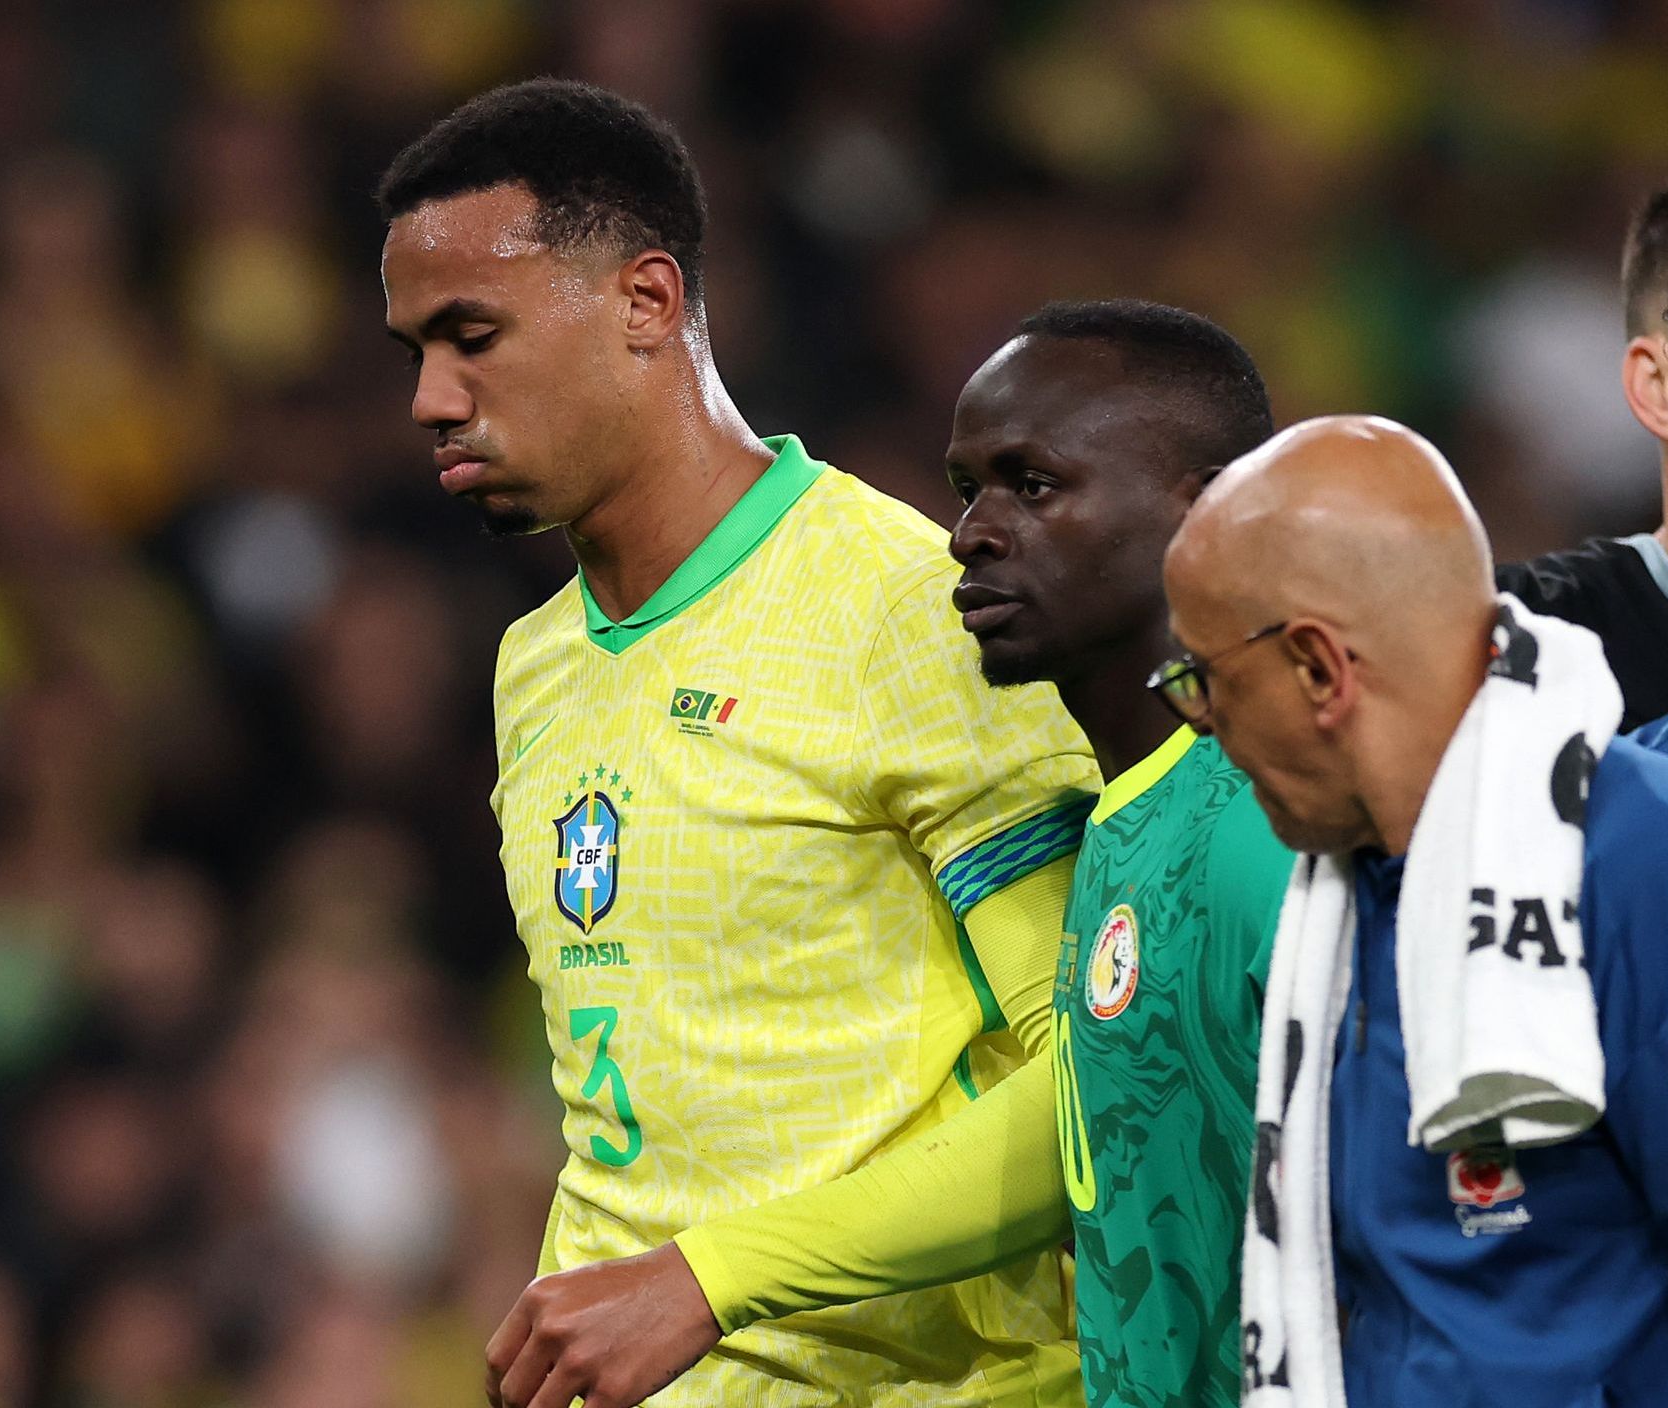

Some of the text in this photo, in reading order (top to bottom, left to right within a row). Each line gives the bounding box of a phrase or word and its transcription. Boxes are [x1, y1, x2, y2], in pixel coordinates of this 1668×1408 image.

[576, 848, 602, 865] CBF
[559, 942, 630, 970] BRASIL
[569, 1006, 642, 1168] 3
